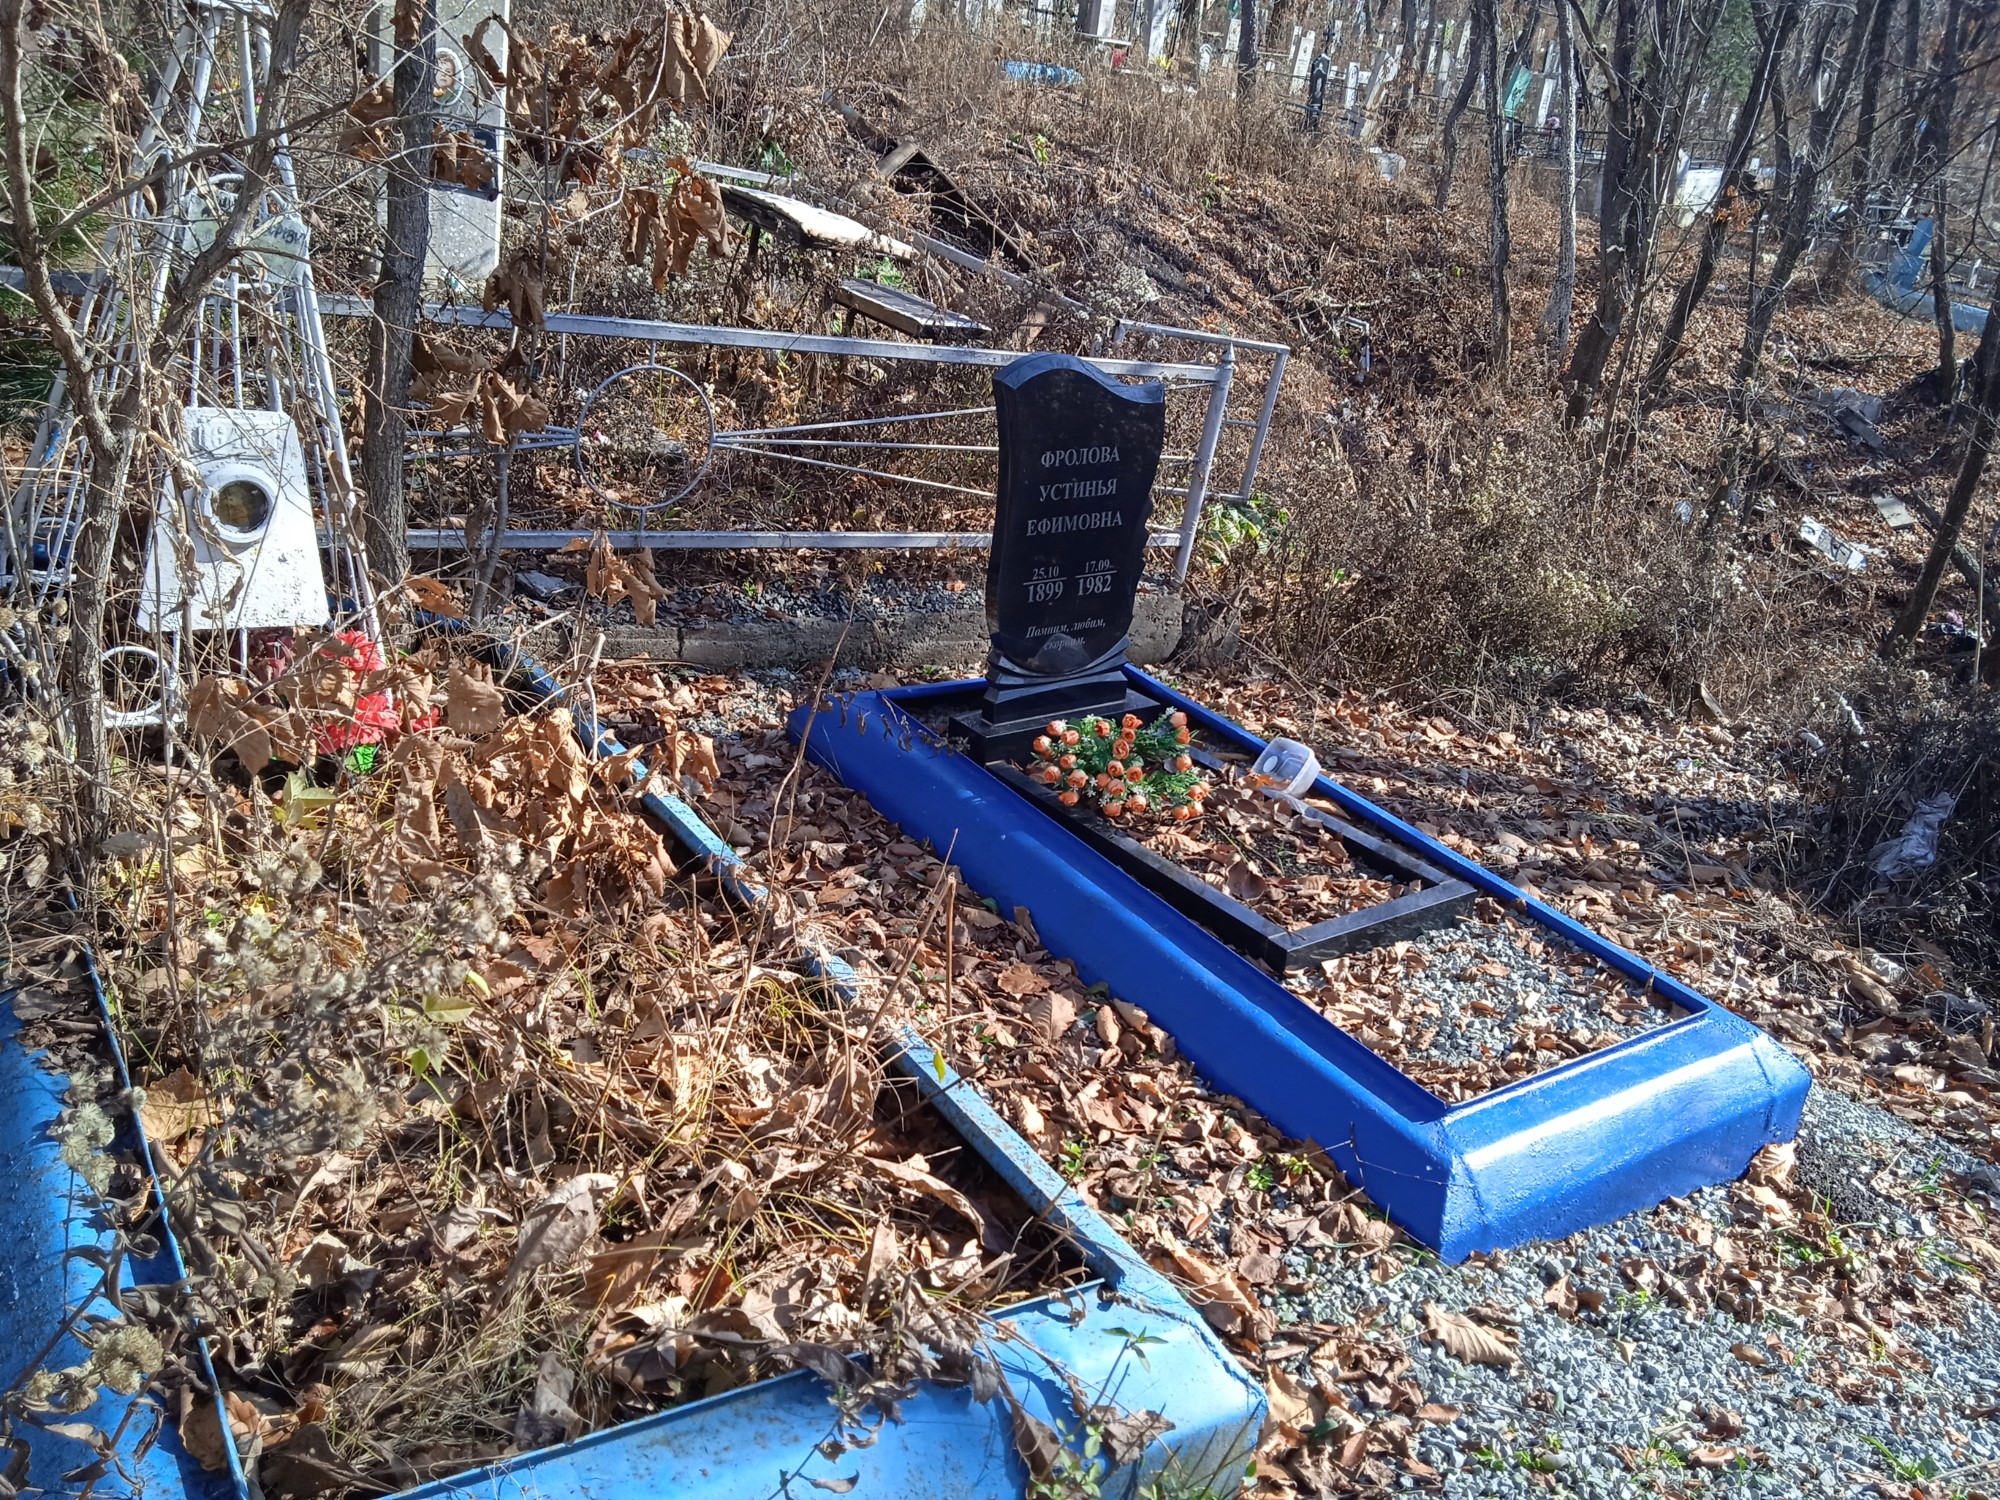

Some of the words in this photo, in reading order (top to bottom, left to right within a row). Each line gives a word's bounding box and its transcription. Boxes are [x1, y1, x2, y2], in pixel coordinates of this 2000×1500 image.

[1041, 446, 1120, 468] ФРОЛОВА
[1040, 478, 1118, 502] УСТИНЬЯ
[1026, 510, 1122, 536] ЕФИМОВНА
[1032, 565, 1060, 581] 25.10
[1085, 559, 1111, 573] 17.09
[1027, 581, 1064, 603] 1899
[1077, 574, 1112, 596] 1982
[1026, 623, 1070, 638] Помним,
[1070, 618, 1106, 632] любим,
